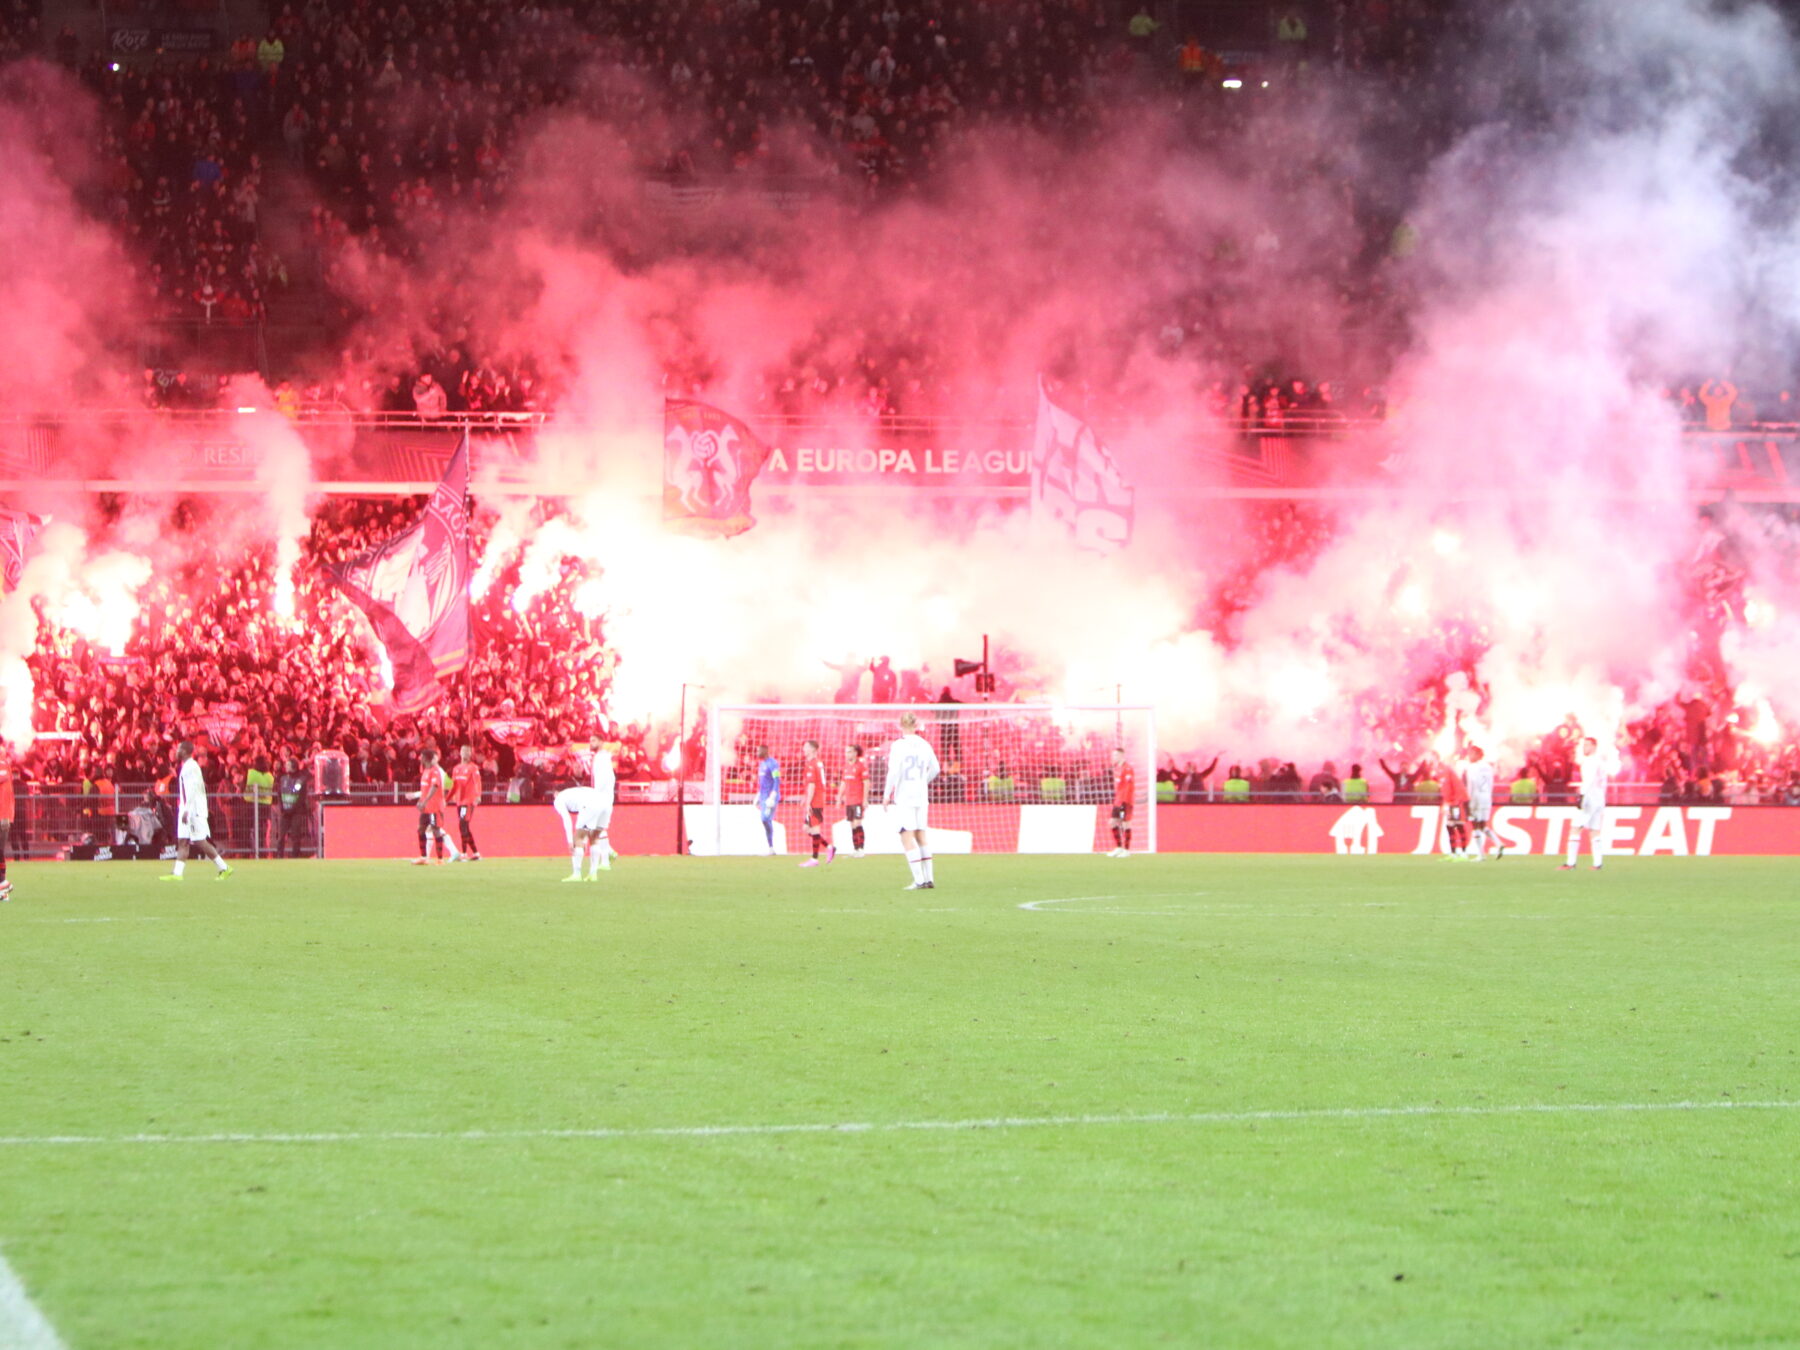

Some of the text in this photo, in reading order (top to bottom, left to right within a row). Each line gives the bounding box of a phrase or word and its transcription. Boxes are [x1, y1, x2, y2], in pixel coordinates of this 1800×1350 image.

[797, 448, 917, 473] EUROPA
[904, 755, 924, 782] 24
[1601, 806, 1732, 856] EAT
